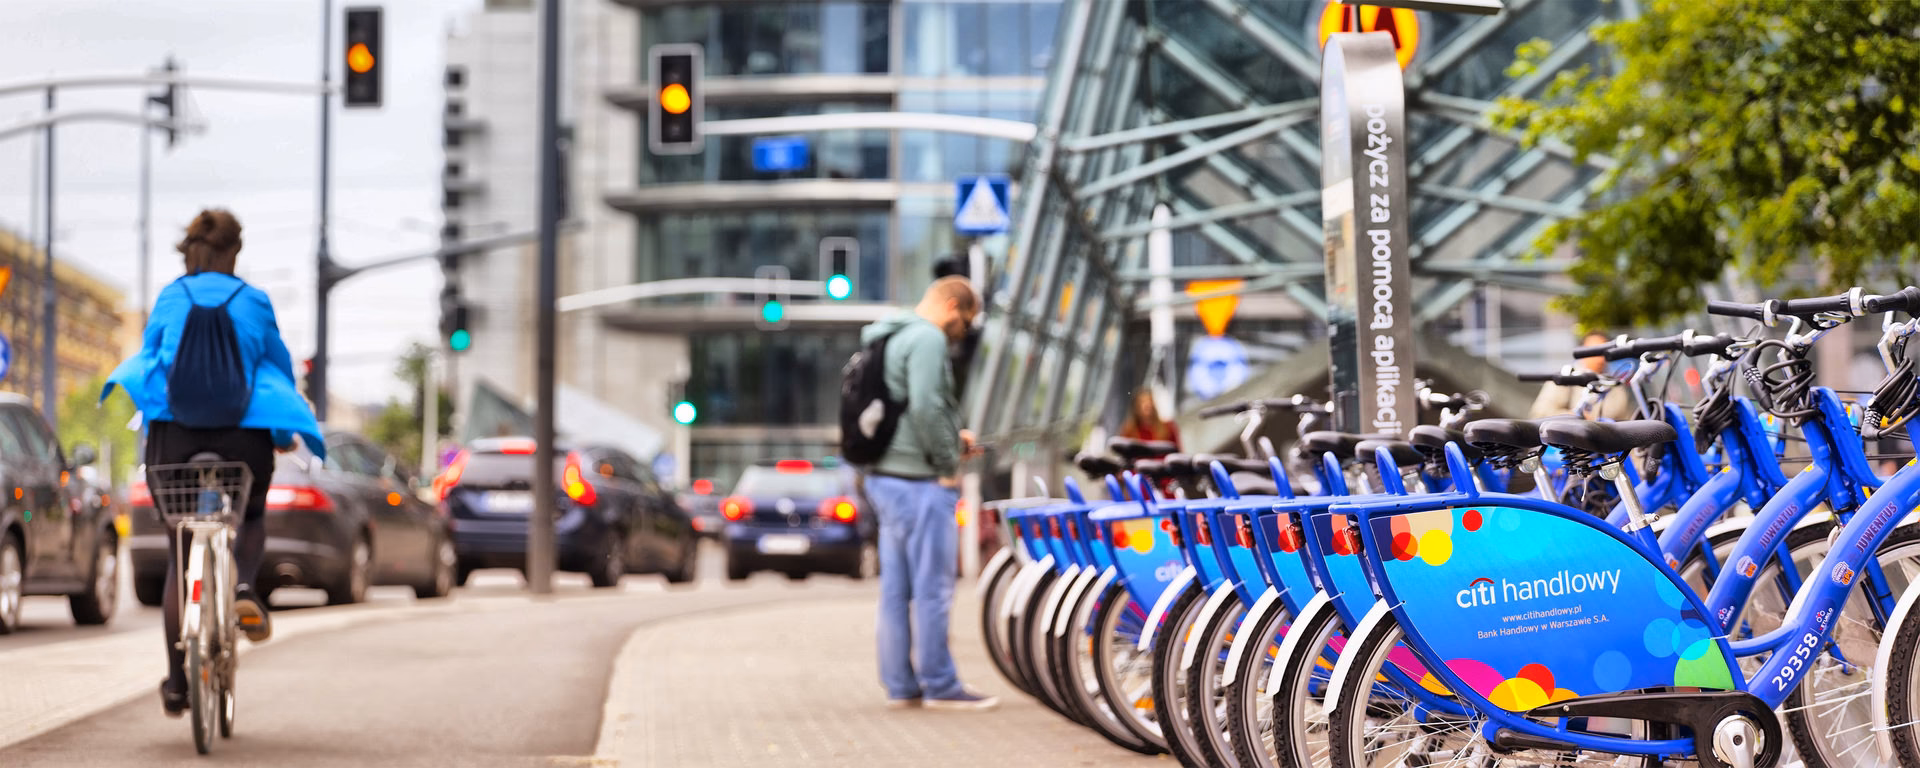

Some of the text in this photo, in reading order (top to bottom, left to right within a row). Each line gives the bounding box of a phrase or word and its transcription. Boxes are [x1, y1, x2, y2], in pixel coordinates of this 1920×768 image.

[1361, 103, 1402, 434] pożycz za pomocą aplikacji
[1759, 503, 1799, 548] JUWENTUS
[1856, 501, 1898, 553] JUWENTUS
[1456, 569, 1621, 609] citi handlowy
[1478, 629, 1498, 640] Bank
[1499, 623, 1539, 637] Handlowy
[1549, 617, 1592, 630] Warszawie
[1594, 614, 1610, 624] S.A.
[1502, 604, 1583, 623] www.citihandlowy.pl
[1771, 632, 1820, 693] 29358
